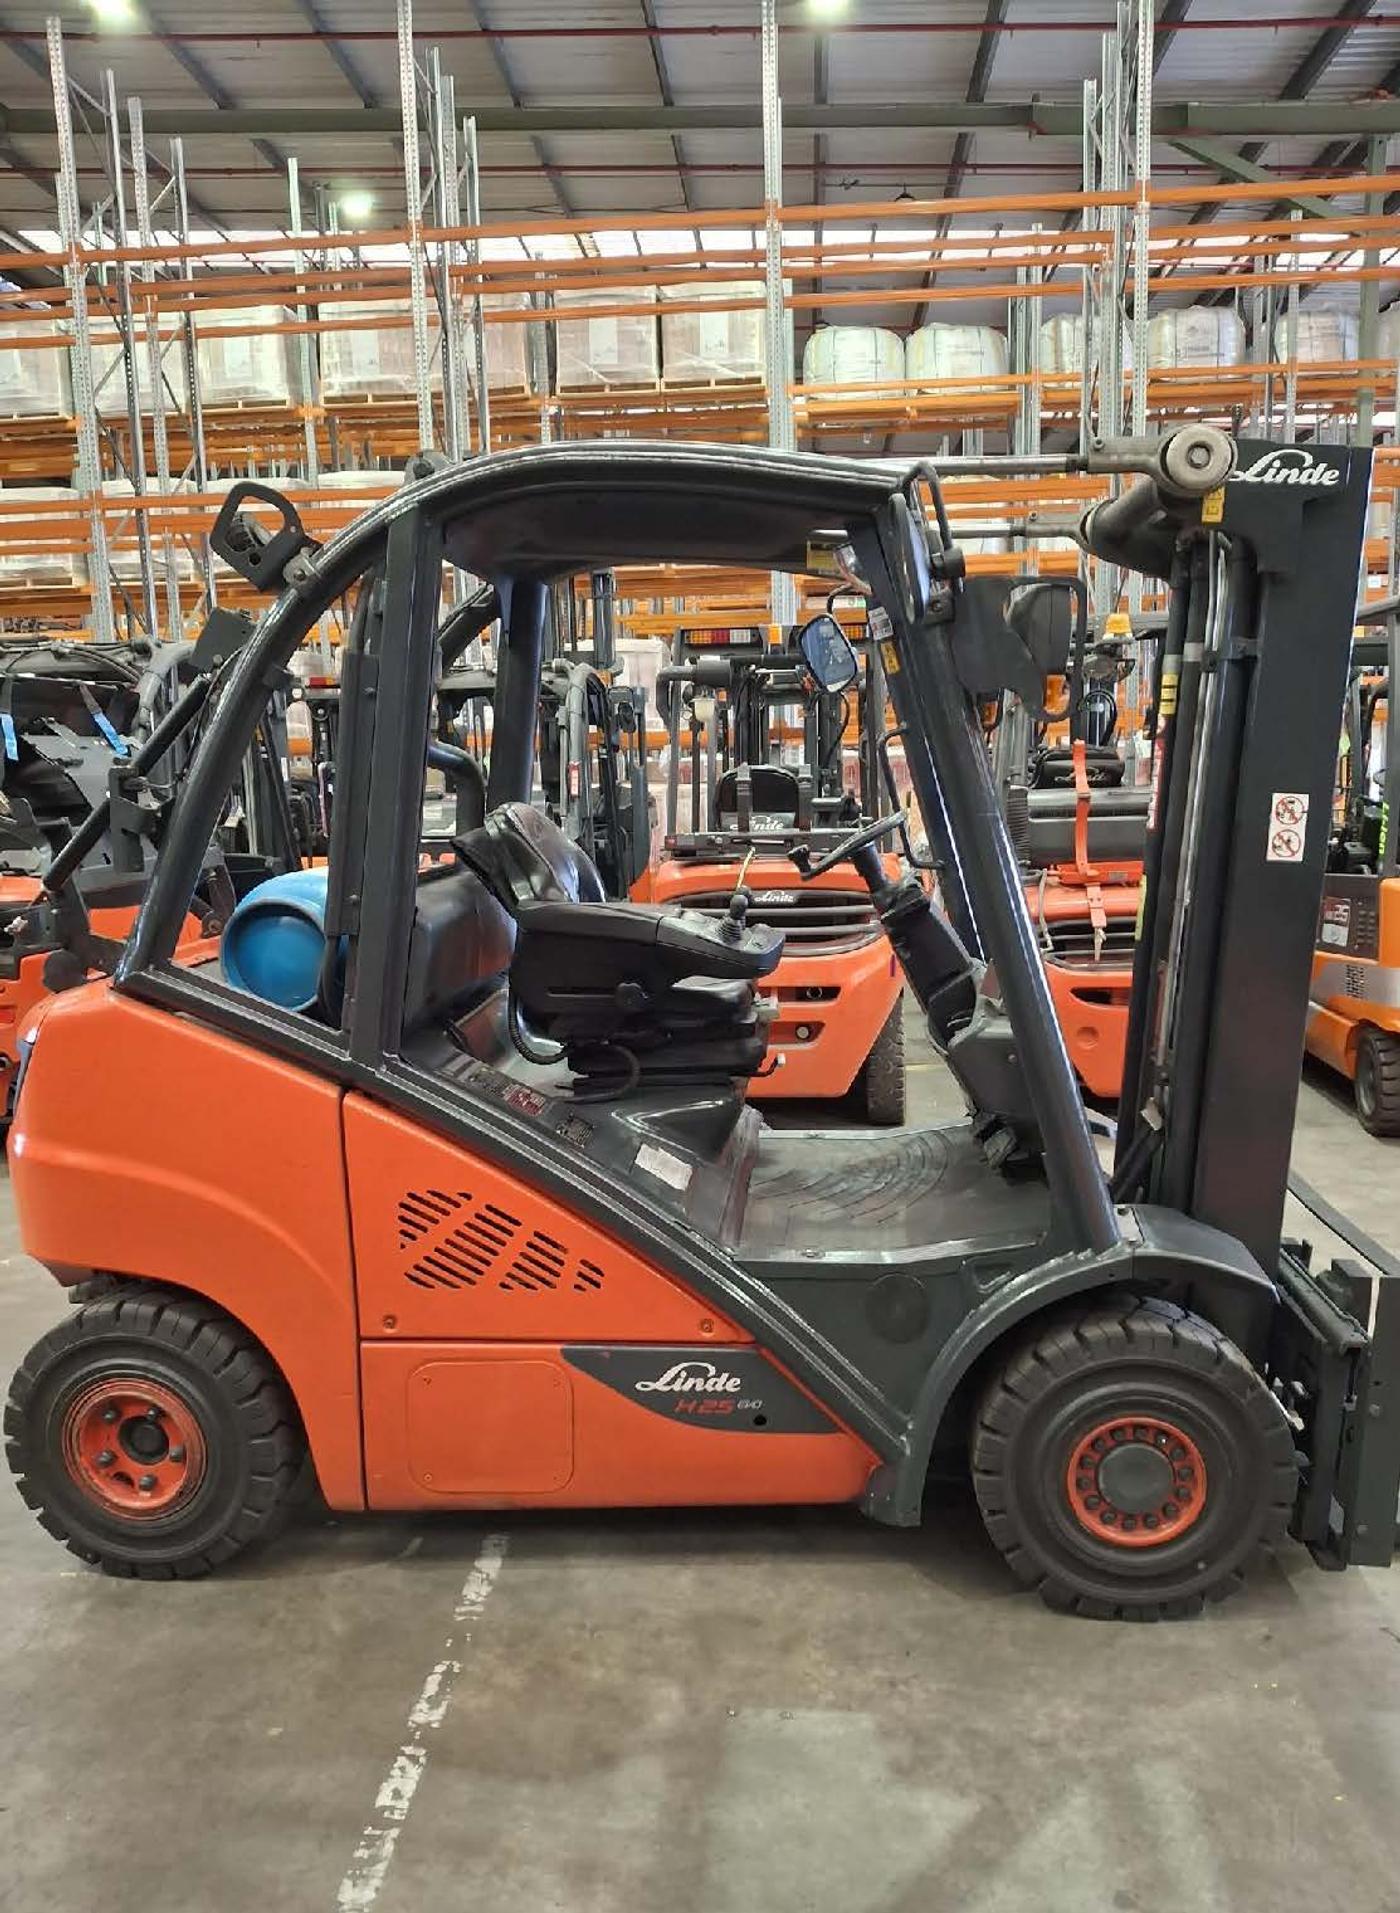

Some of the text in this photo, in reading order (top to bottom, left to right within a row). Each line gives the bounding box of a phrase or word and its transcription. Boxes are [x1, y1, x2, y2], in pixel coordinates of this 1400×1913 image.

[1229, 448, 1340, 485] Linde
[635, 1361, 741, 1392] Linde
[674, 1397, 734, 1415] H25
